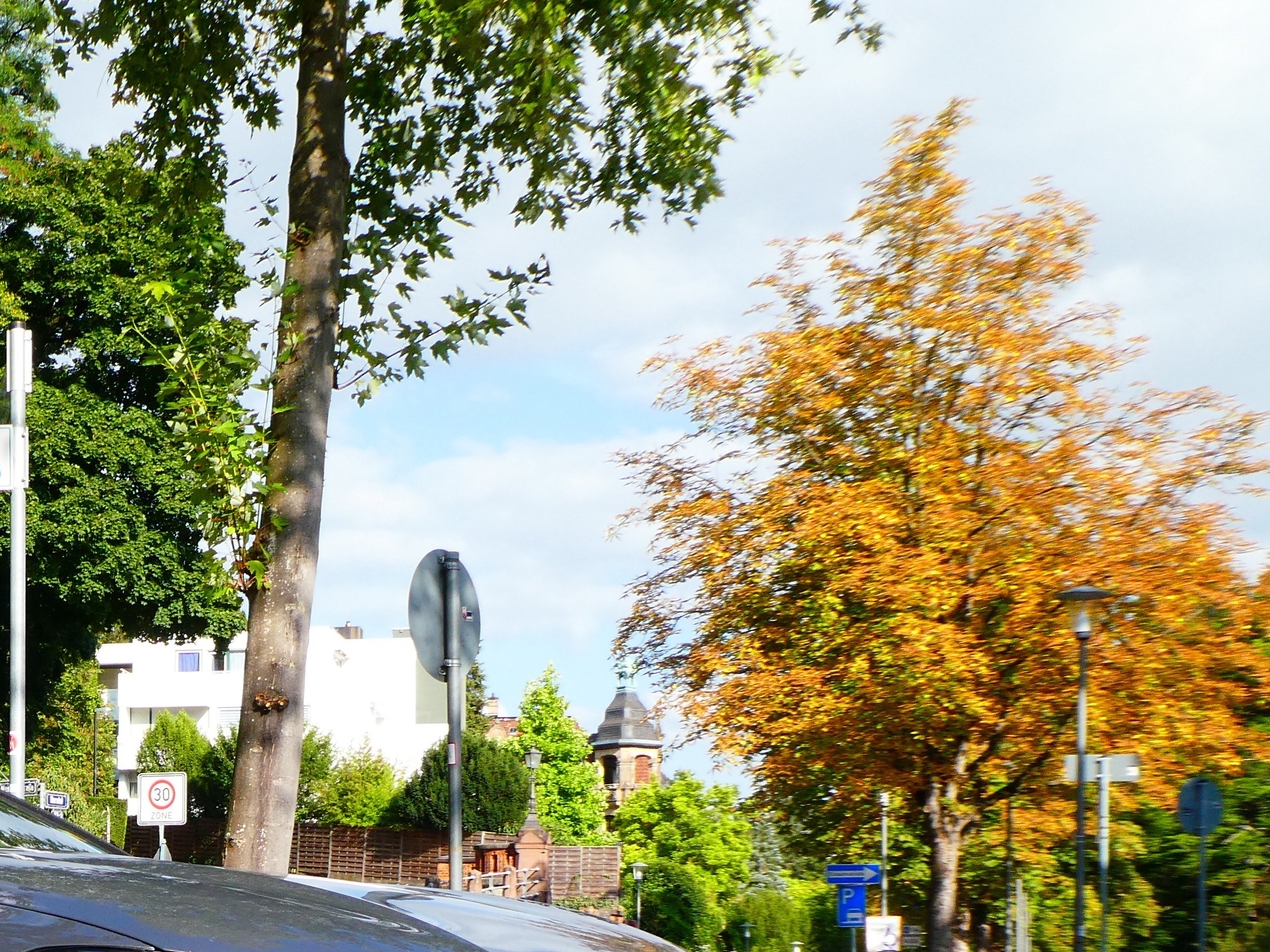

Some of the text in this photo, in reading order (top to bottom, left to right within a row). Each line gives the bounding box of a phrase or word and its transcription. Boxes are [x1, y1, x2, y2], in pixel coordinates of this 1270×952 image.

[153, 787, 170, 801] 30
[151, 811, 173, 820] ZONE
[842, 888, 855, 905] P
